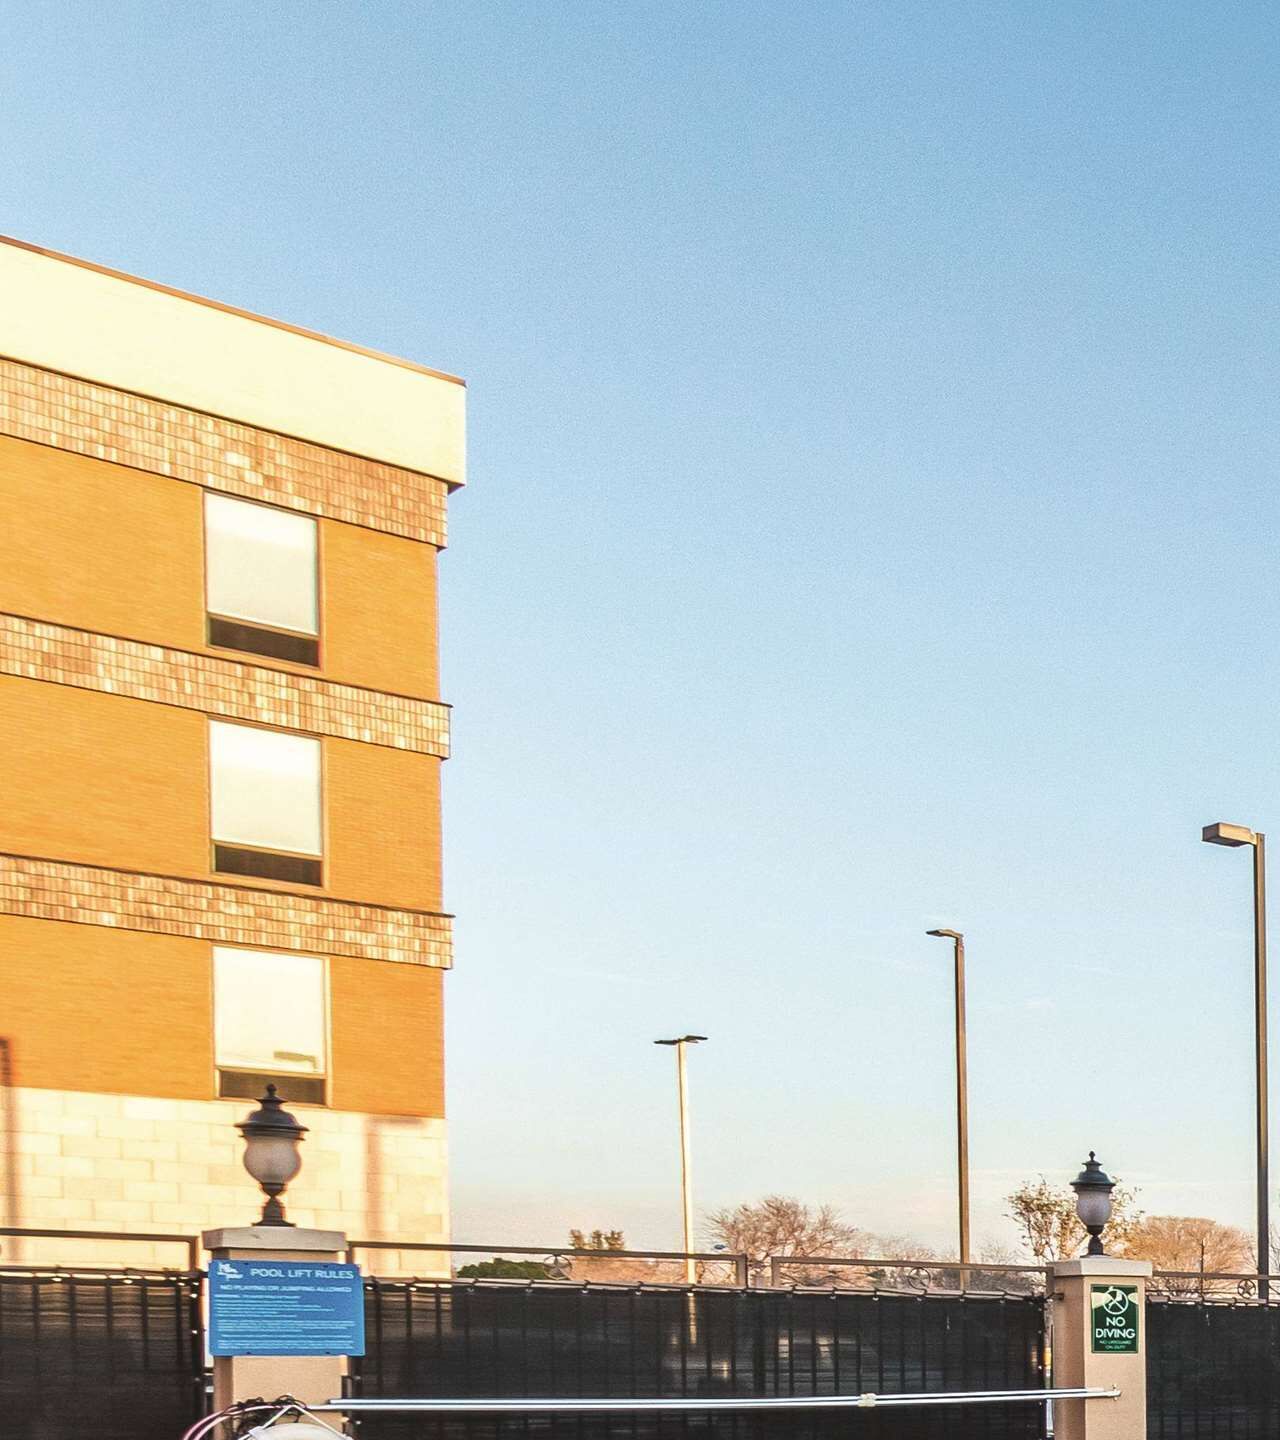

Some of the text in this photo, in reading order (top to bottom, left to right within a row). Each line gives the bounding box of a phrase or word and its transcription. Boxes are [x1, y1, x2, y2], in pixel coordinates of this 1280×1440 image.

[251, 1268, 286, 1278] POOL
[287, 1269, 313, 1278] LIFT
[314, 1270, 354, 1279] RULES
[1106, 1316, 1126, 1327] NO
[1095, 1328, 1136, 1339] DIVING
